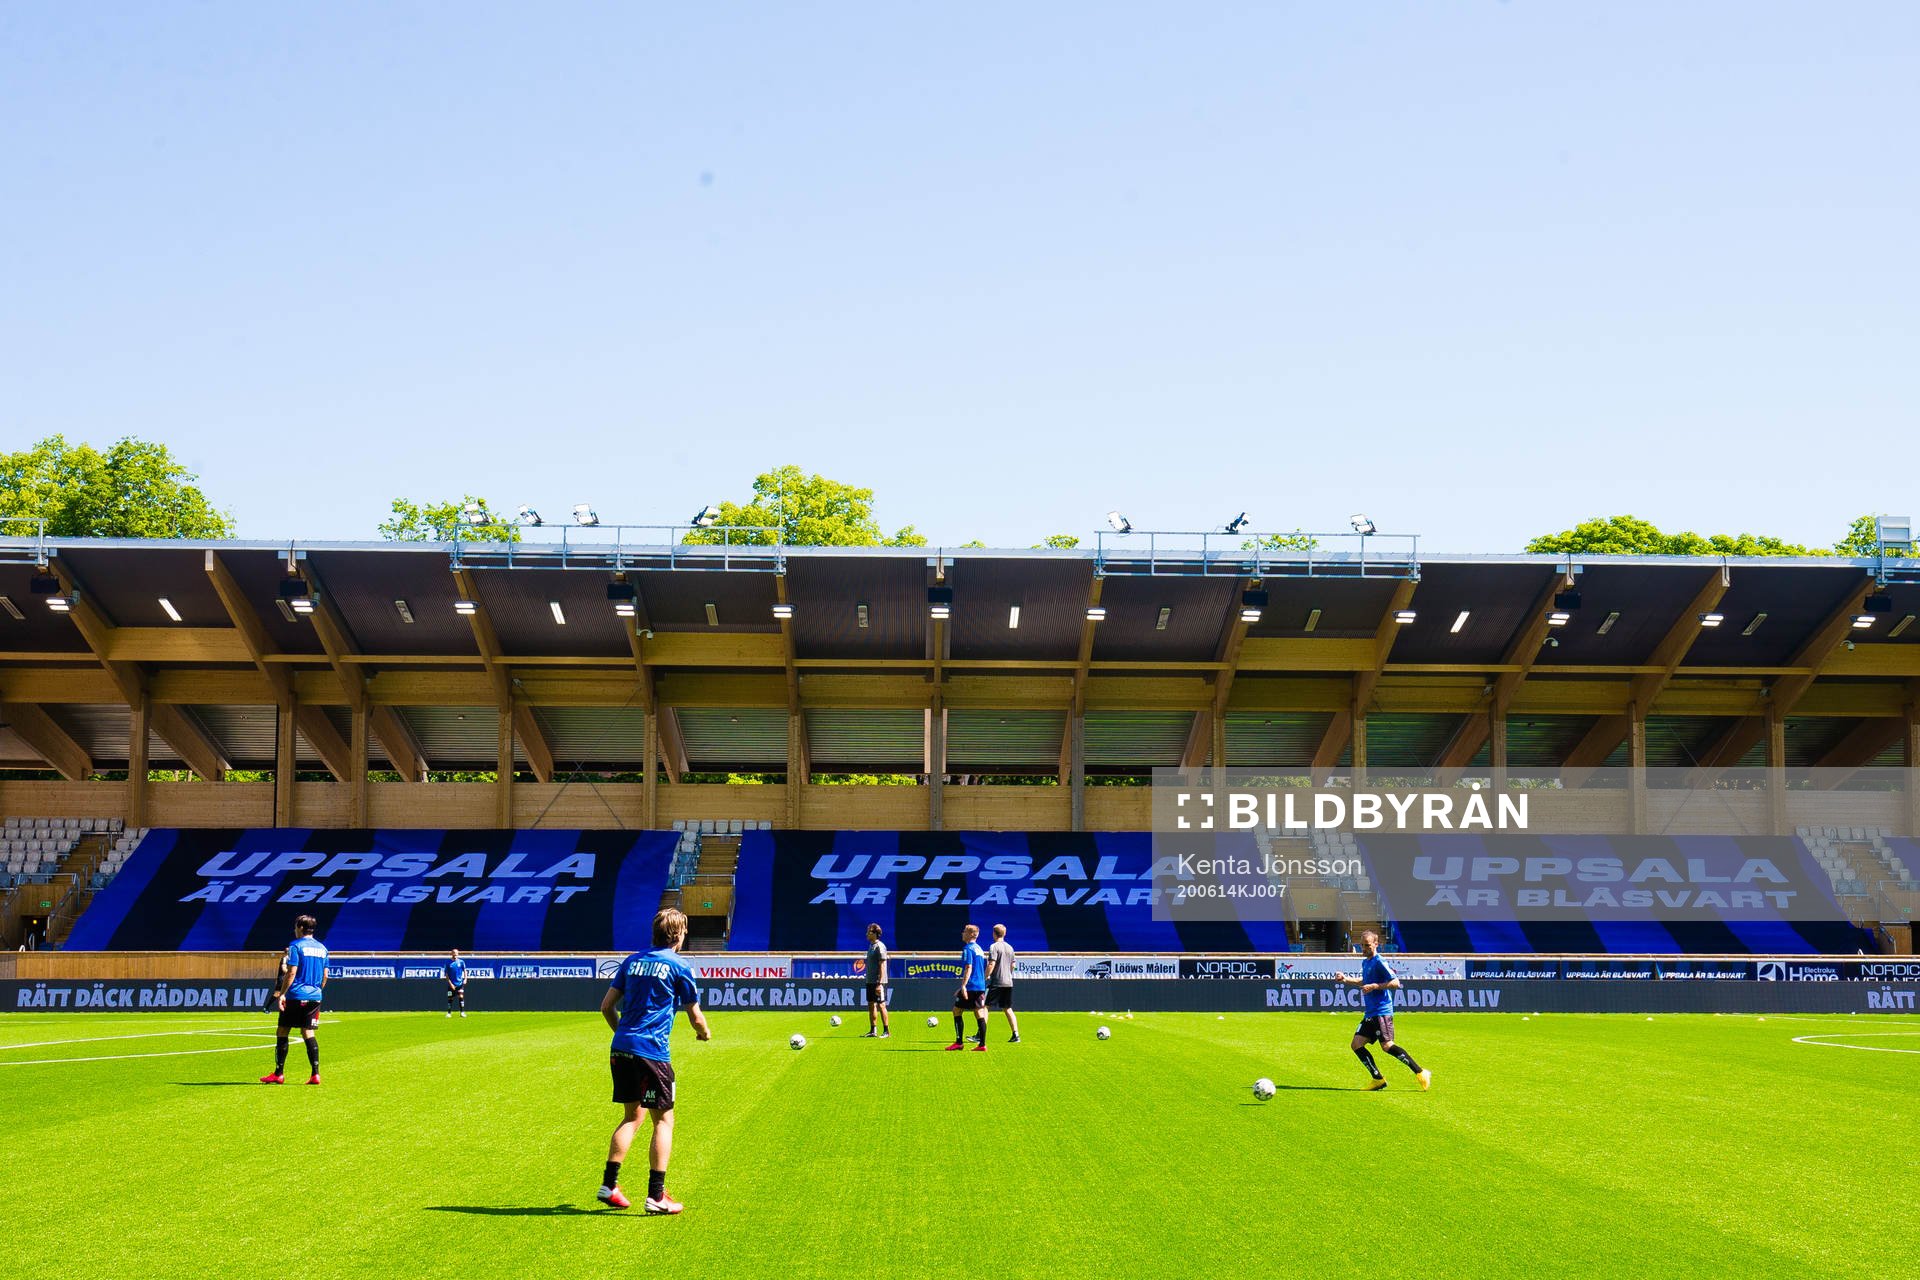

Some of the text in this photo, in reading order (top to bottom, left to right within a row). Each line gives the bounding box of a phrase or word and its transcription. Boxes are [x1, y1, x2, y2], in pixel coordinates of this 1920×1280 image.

[196, 852, 596, 878] UPPSALA
[810, 854, 1196, 881] UPPSALA
[1412, 856, 1790, 883] UPPSALA
[178, 881, 590, 904] ÄR BLÅSVART
[808, 883, 1192, 906] ÄR BLÅSVART
[1425, 885, 1798, 909] ÄR BLÅSVART
[405, 969, 440, 978] SKROT
[542, 968, 589, 976] CENTRALEN
[627, 961, 671, 980] SIRIUS
[700, 967, 787, 978] VIKING LINE
[908, 962, 963, 976] Skuttung
[1019, 962, 1074, 974] ByggPartner
[1114, 963, 1176, 974] Lööws Måleri
[1196, 961, 1257, 974] NORDIC
[1505, 970, 1516, 978] ÄR
[1566, 971, 1600, 979] UPPSALA
[1600, 970, 1611, 979] ÄR
[1789, 967, 1839, 981] Home
[1861, 964, 1920, 976] NORDIC
[1695, 971, 1706, 979] ÄR
[16, 983, 269, 1007] RÄTT DÄCK RÄDDAR LIV
[708, 983, 764, 1006] DÄCK
[769, 983, 855, 1006] RÄDDAR
[860, 988, 894, 1006] LV
[1266, 983, 1315, 1007] RÄTT
[1393, 984, 1464, 1007] ÄDDAR
[1468, 989, 1501, 1007] LIV
[1867, 986, 1915, 1009] RÄTT
[645, 1089, 656, 1099] AK
